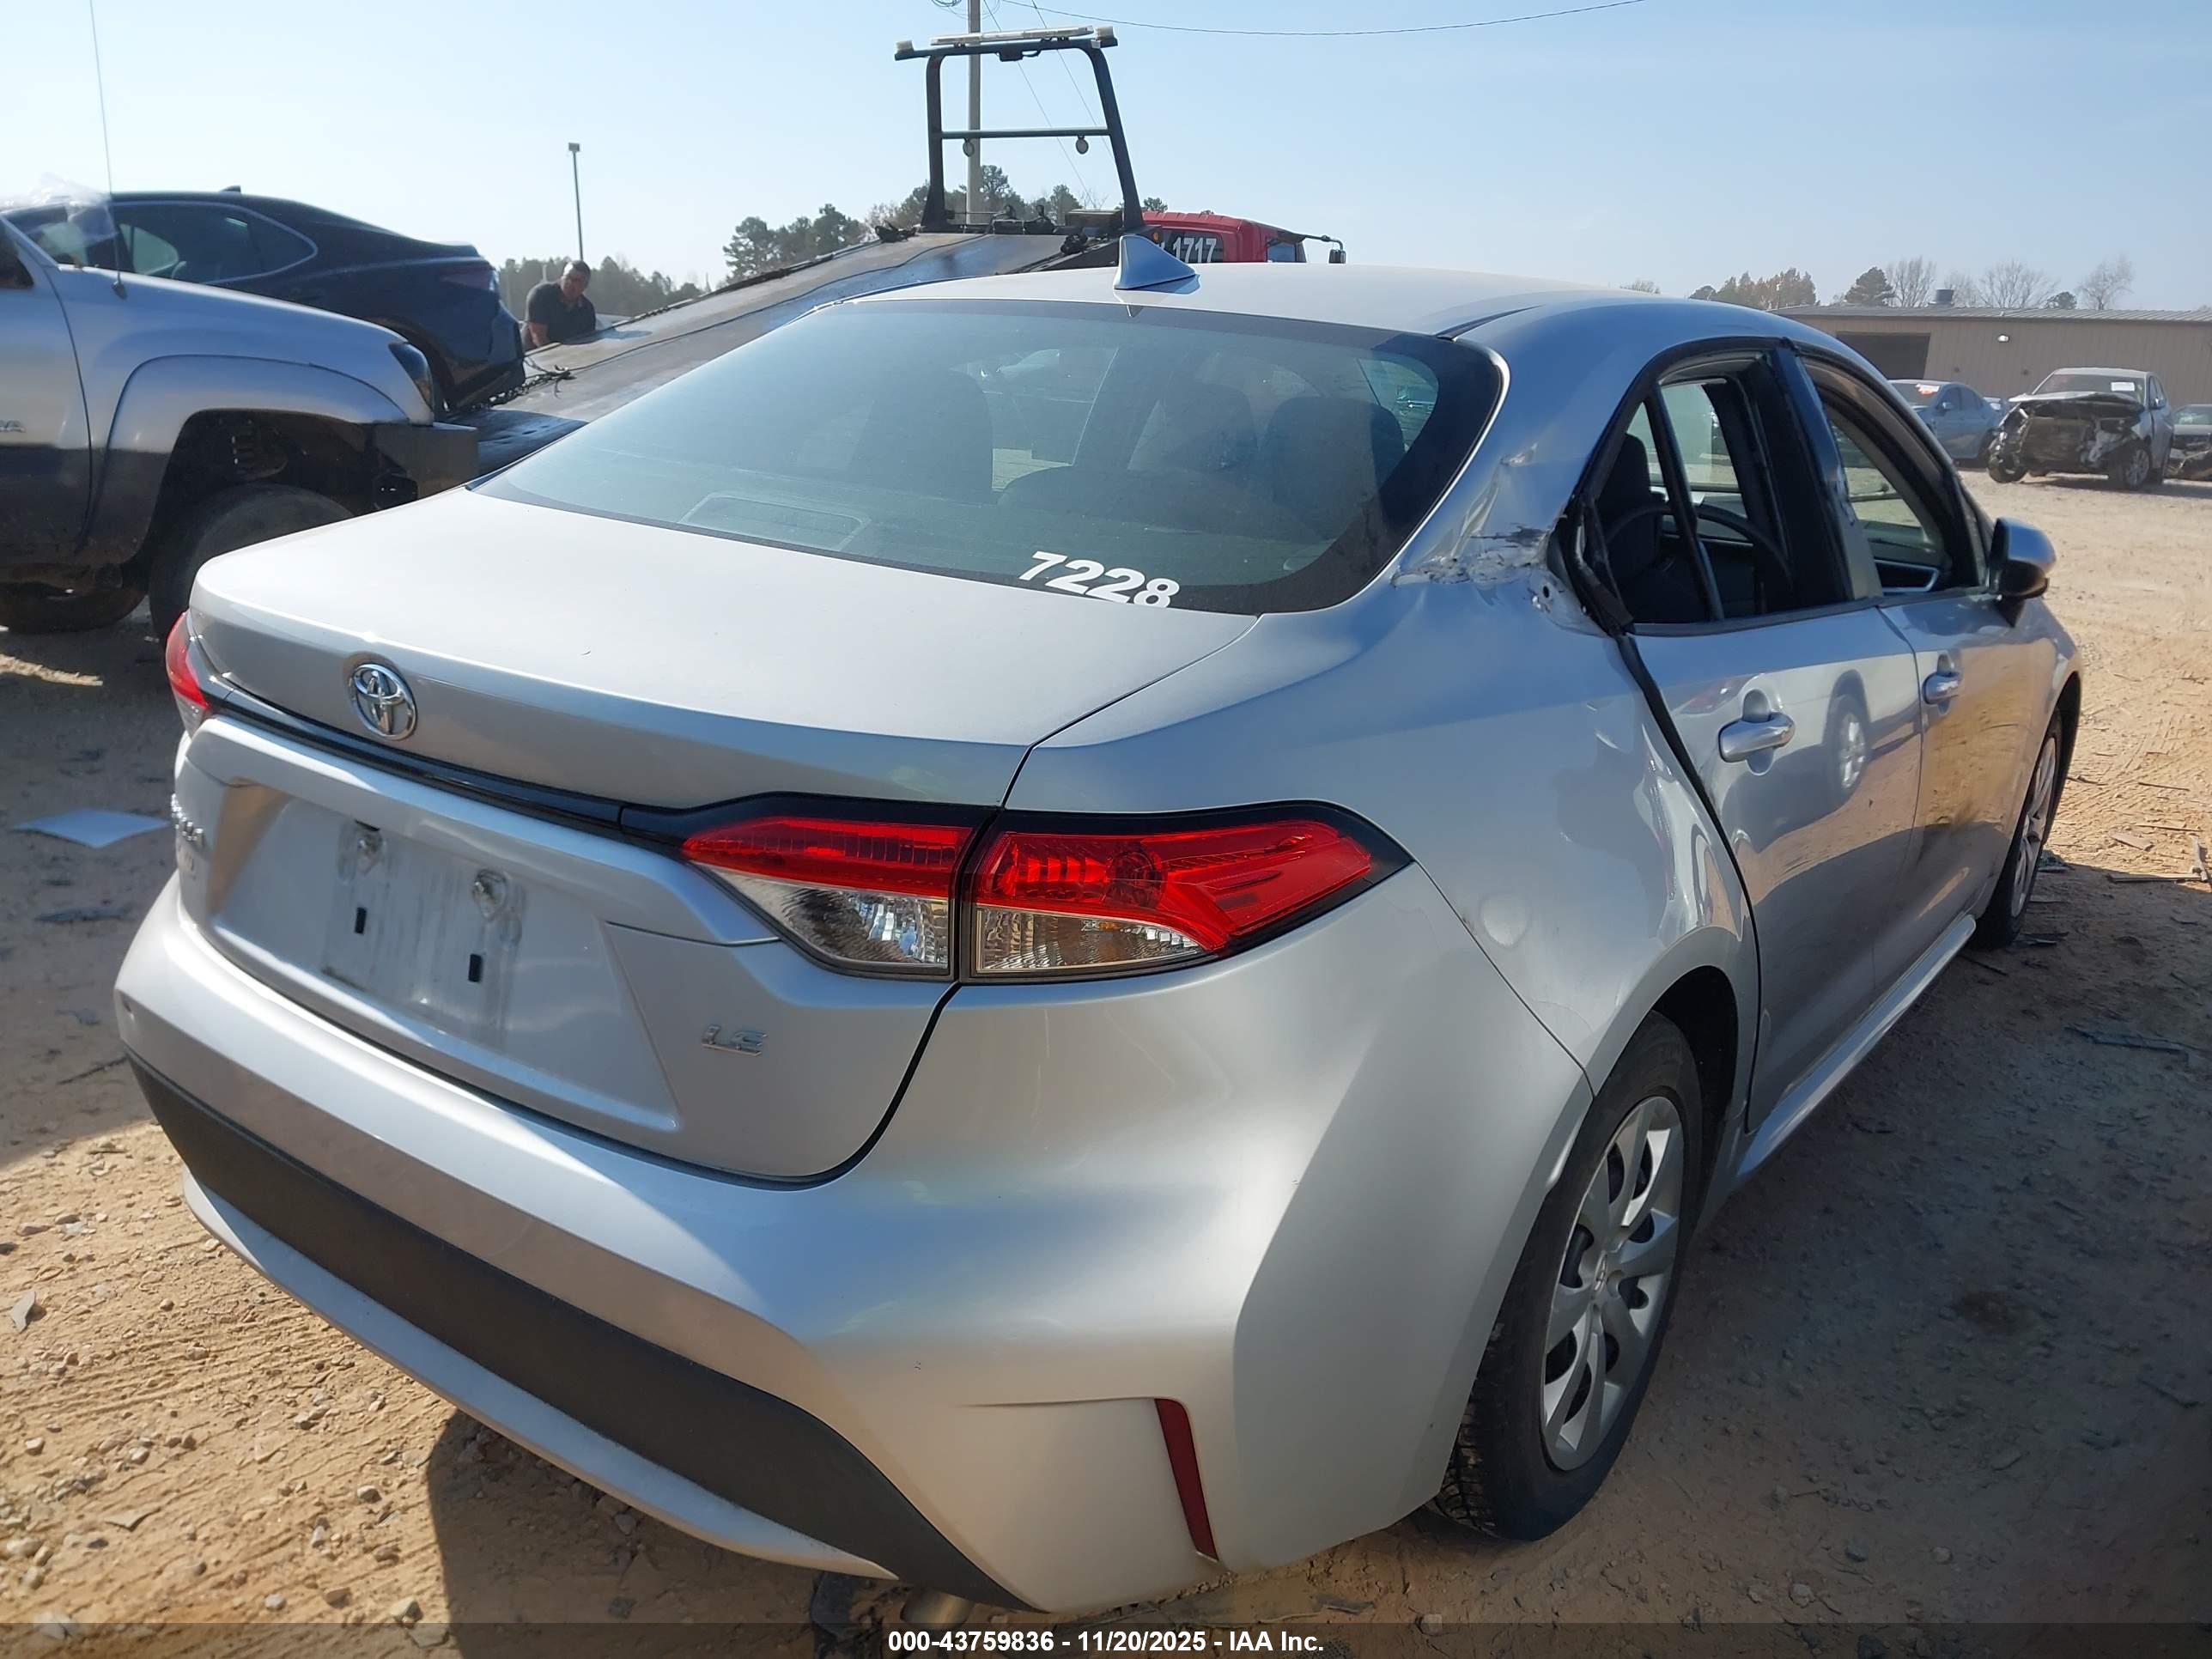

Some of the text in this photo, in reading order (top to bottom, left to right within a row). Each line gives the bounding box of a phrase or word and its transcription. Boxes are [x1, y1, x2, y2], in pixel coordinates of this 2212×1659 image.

[1173, 237, 1217, 263] 1717
[1018, 550, 1180, 608] 7228
[702, 1024, 769, 1057] LE
